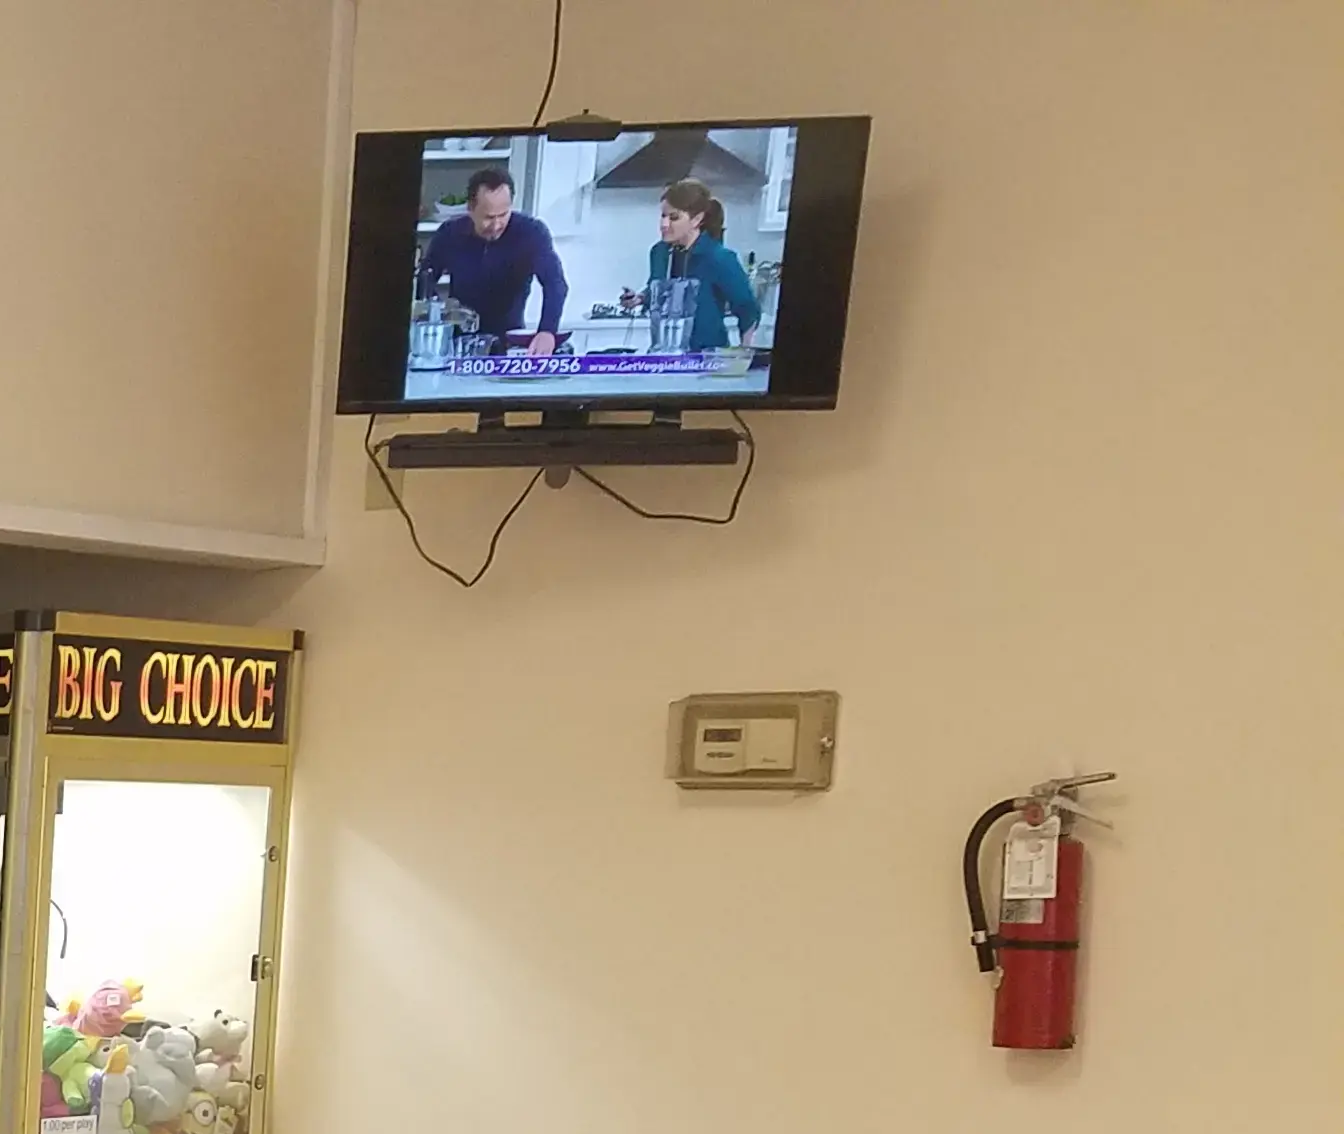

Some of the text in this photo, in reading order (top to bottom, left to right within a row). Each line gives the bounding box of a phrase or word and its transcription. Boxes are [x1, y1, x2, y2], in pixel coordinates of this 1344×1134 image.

[446, 357, 582, 375] 1-800-720-7956
[55, 642, 277, 730] BIG CHOICE
